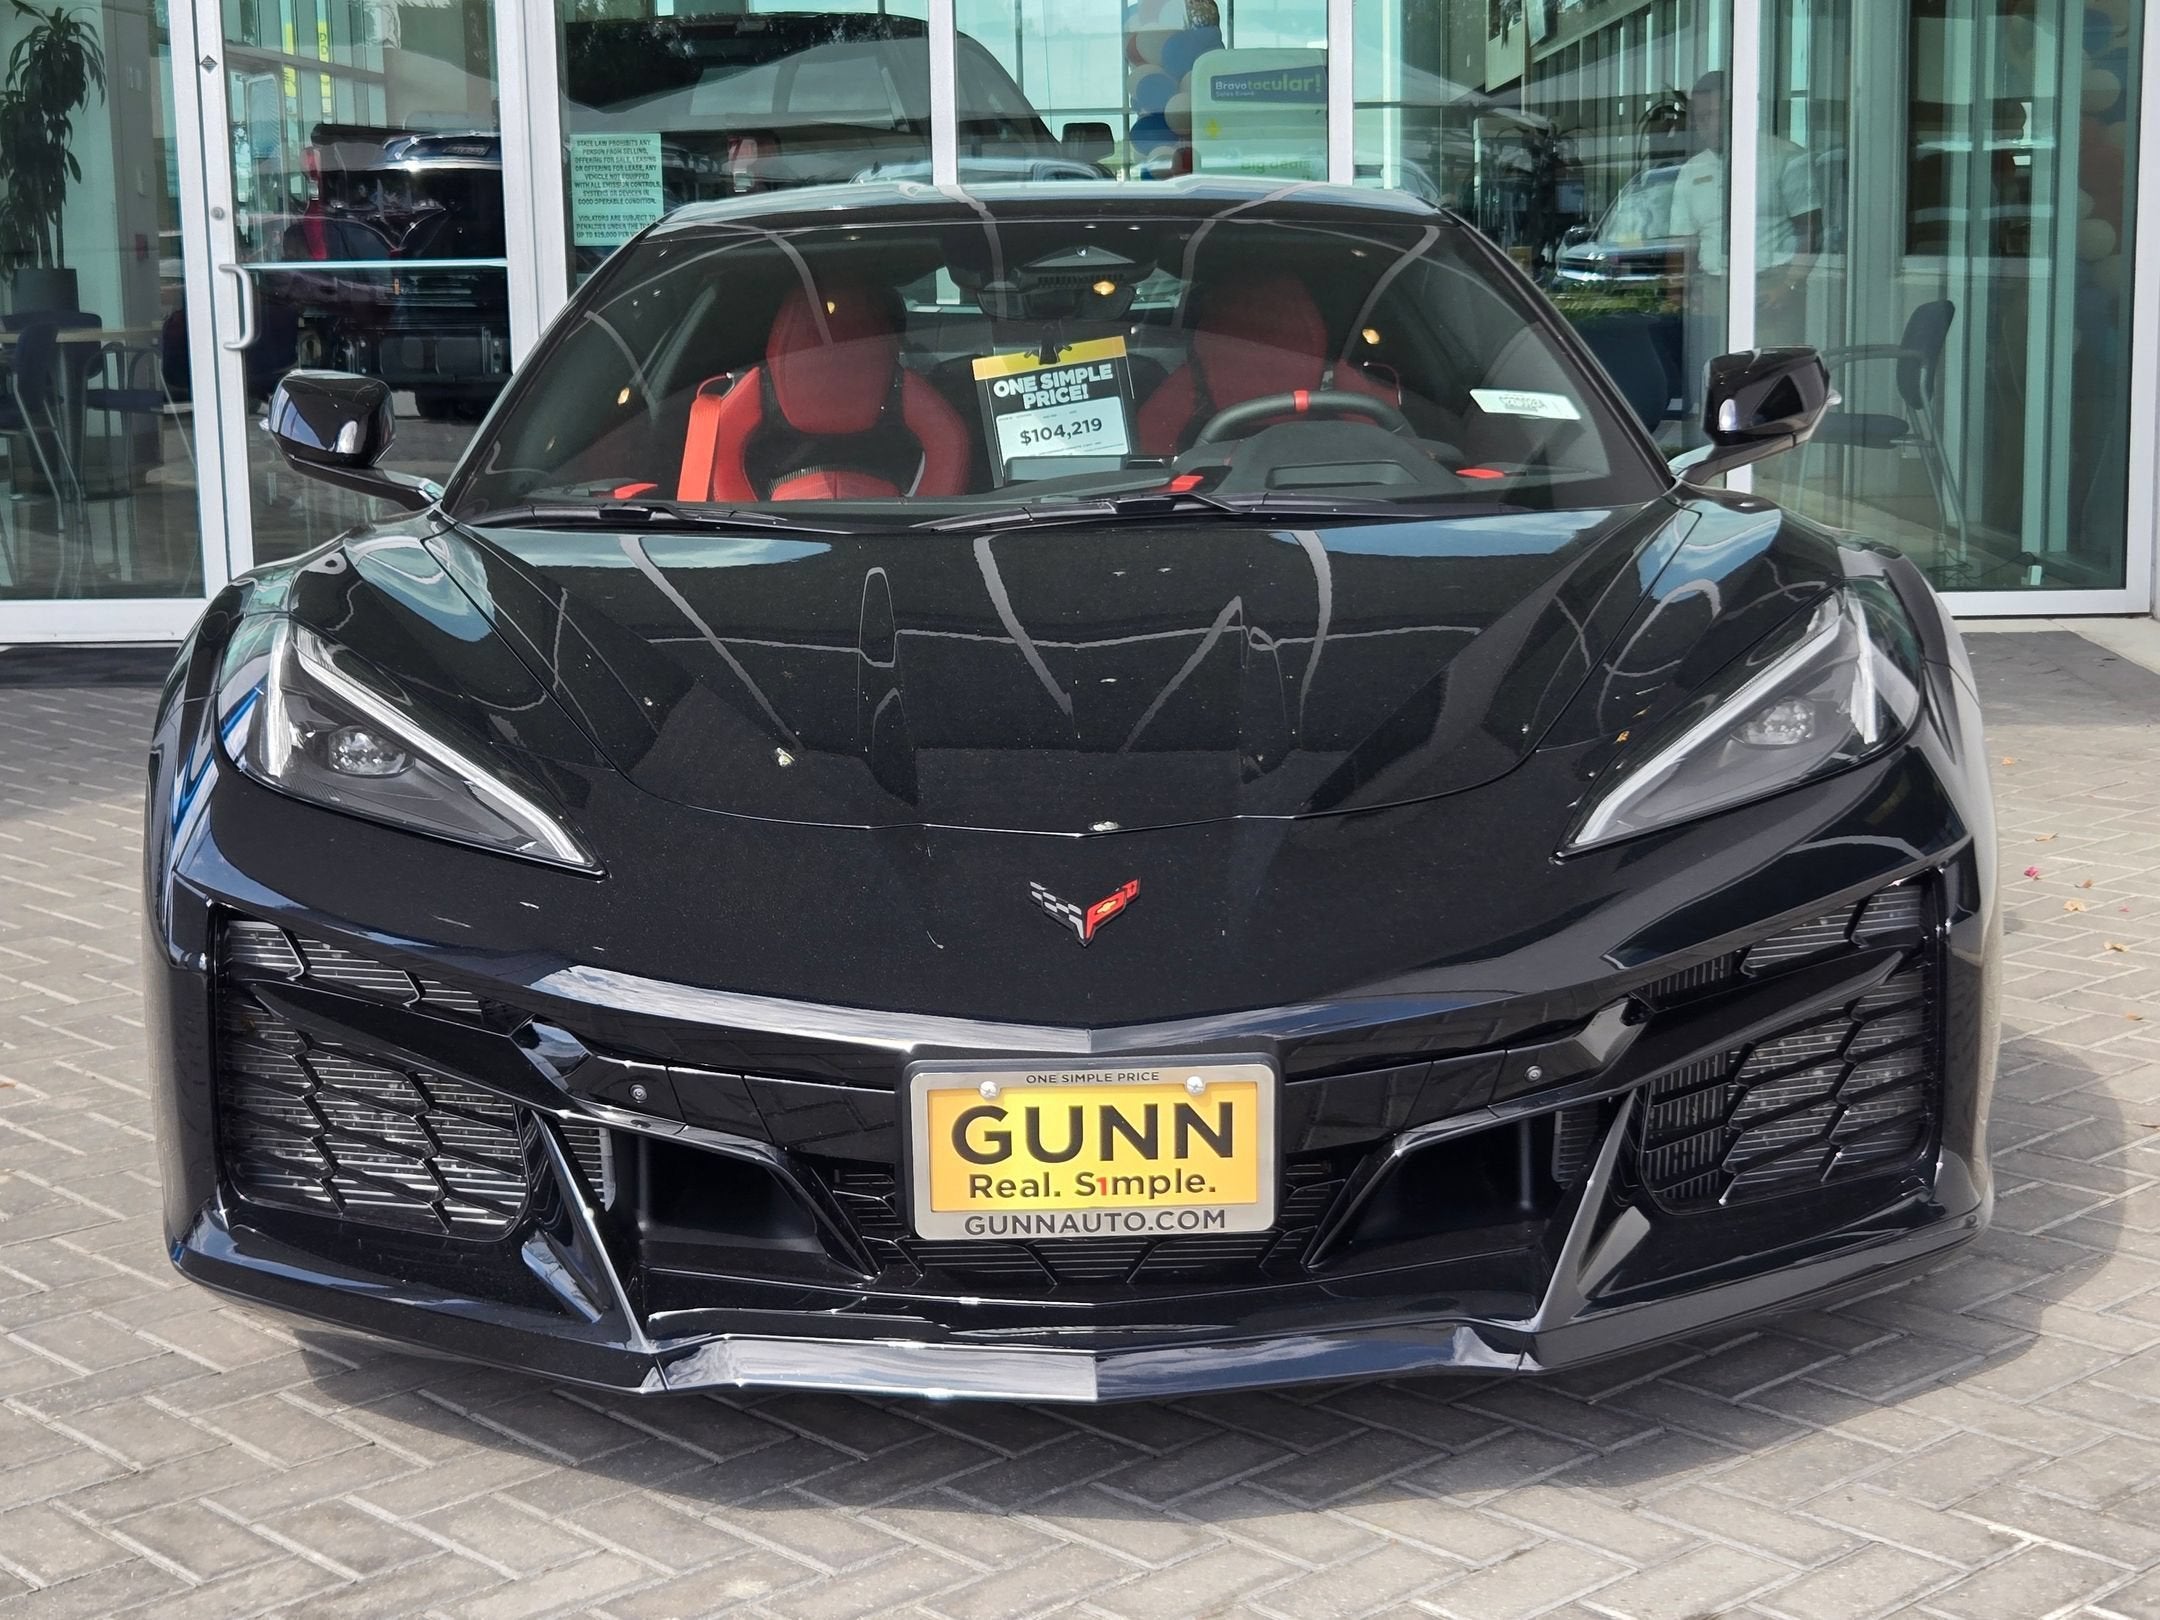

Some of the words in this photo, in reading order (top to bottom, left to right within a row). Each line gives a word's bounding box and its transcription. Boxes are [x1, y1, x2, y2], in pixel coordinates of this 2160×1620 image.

[1215, 73, 1321, 93] Bravotacular!
[993, 375, 1038, 398] ONE
[1039, 363, 1113, 390] SIMPLE
[1023, 383, 1089, 410] PRICE!
[1020, 418, 1103, 446] $104,219
[1026, 1074, 1057, 1085] ONE
[1061, 1072, 1113, 1083] SIMPLE
[1117, 1071, 1160, 1082] PRICE
[950, 1101, 1233, 1165] GUNN
[968, 1171, 1061, 1199] Real.
[964, 1209, 1226, 1236] GUNNAUTO.COM
